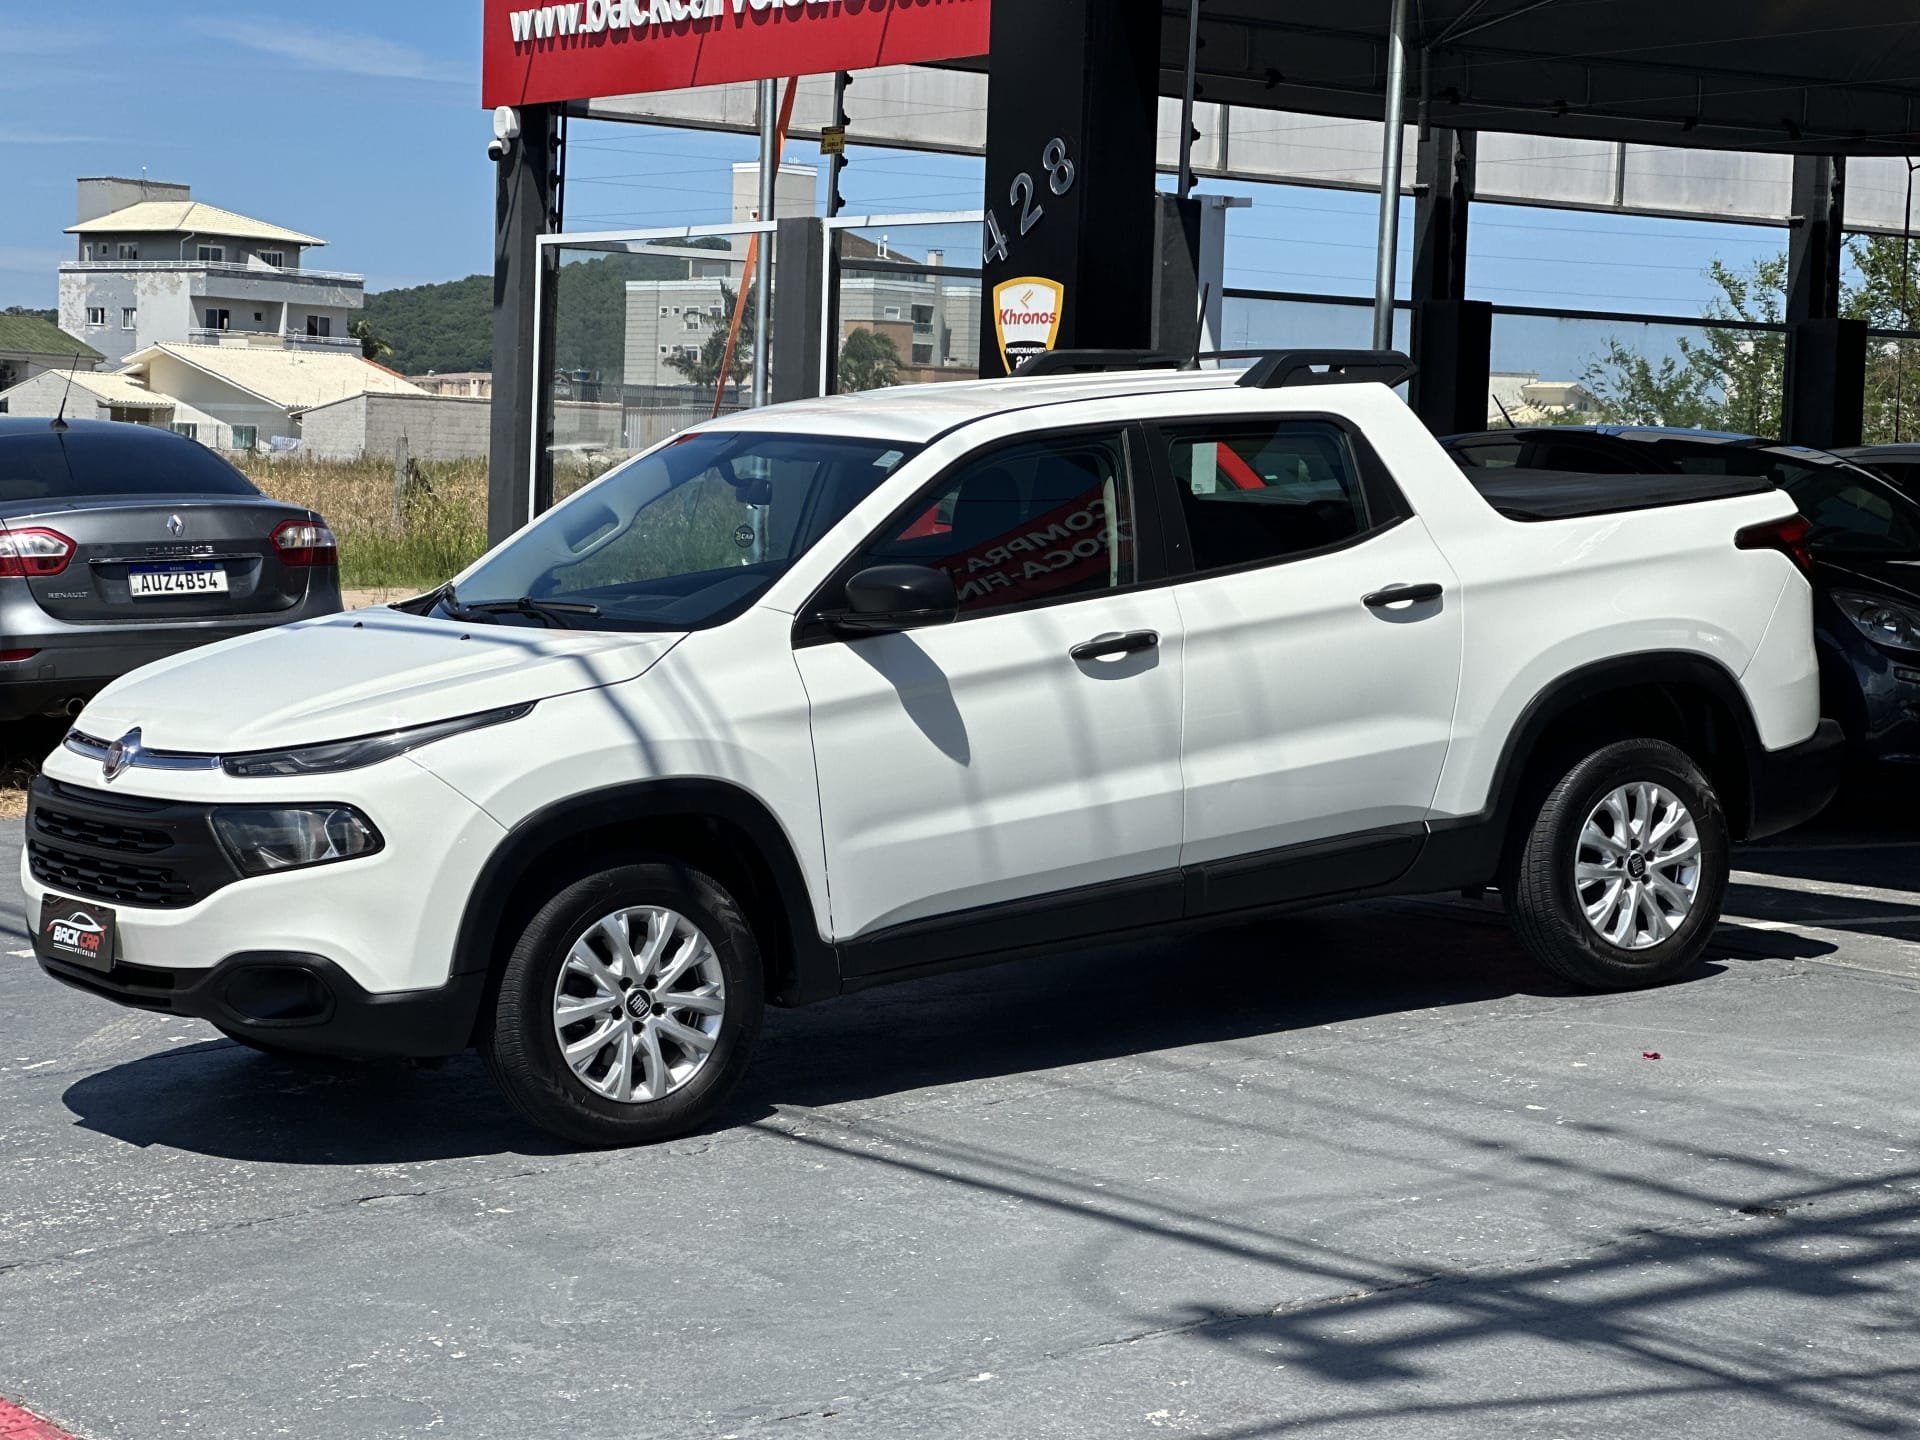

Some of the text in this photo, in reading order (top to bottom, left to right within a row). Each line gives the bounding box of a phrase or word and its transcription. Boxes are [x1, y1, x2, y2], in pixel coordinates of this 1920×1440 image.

[983, 137, 1074, 264] 428
[998, 308, 1057, 326] Khronos
[142, 573, 218, 593] AUZ4B54
[47, 591, 88, 599] RENAULT
[630, 993, 649, 1015] FIAT
